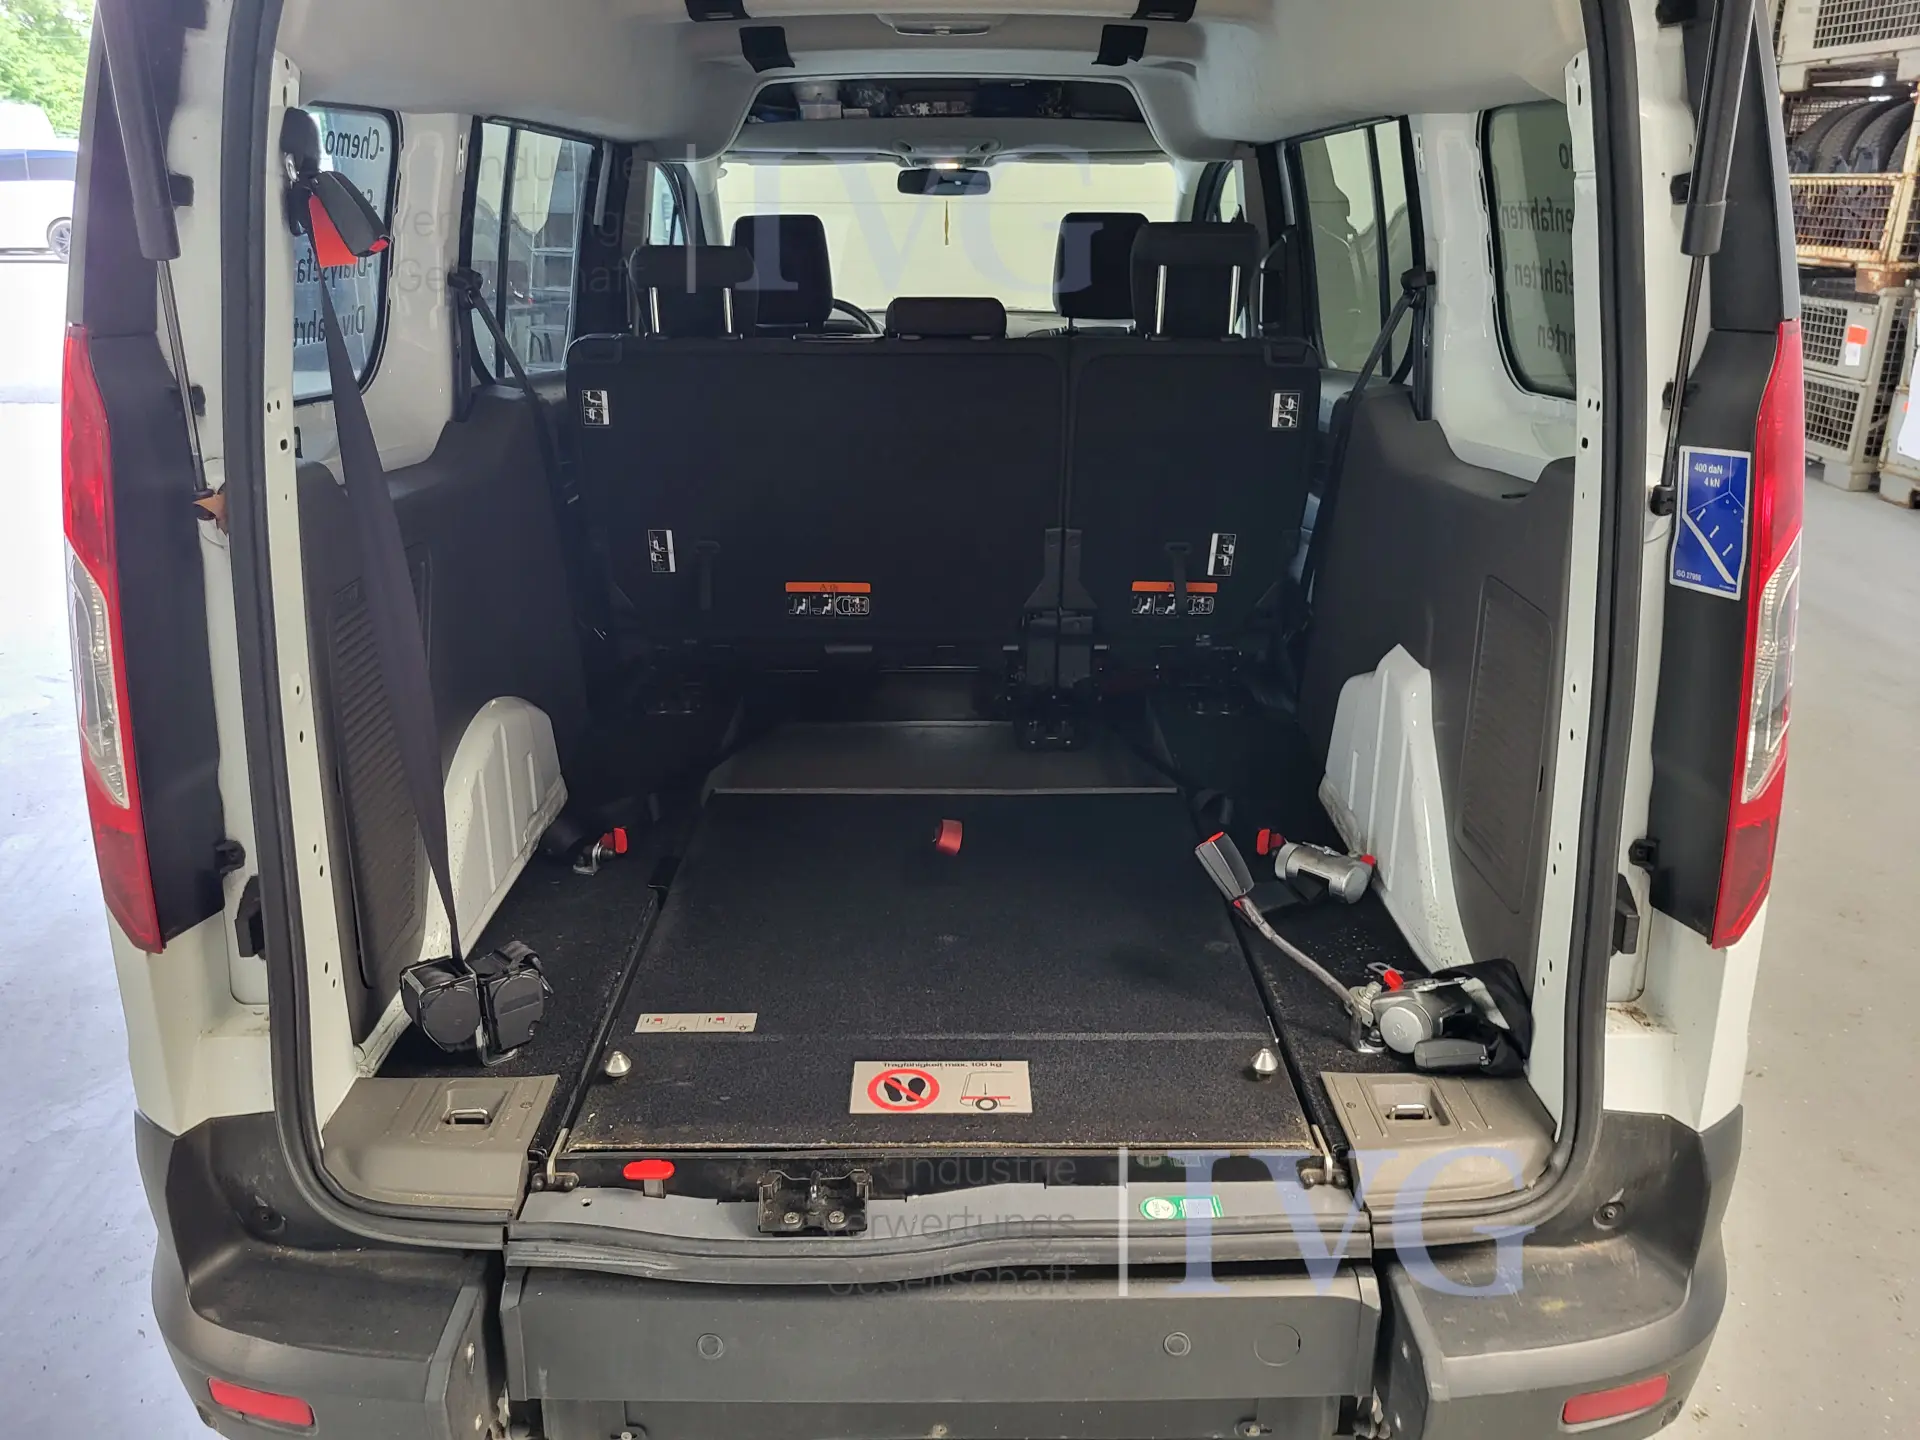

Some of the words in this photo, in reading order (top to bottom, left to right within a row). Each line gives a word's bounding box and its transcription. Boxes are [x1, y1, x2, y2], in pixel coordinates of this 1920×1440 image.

[1694, 462, 1708, 473] 400
[1708, 463, 1723, 475] daN
[1703, 477, 1709, 487] 4
[1710, 478, 1721, 488] kN
